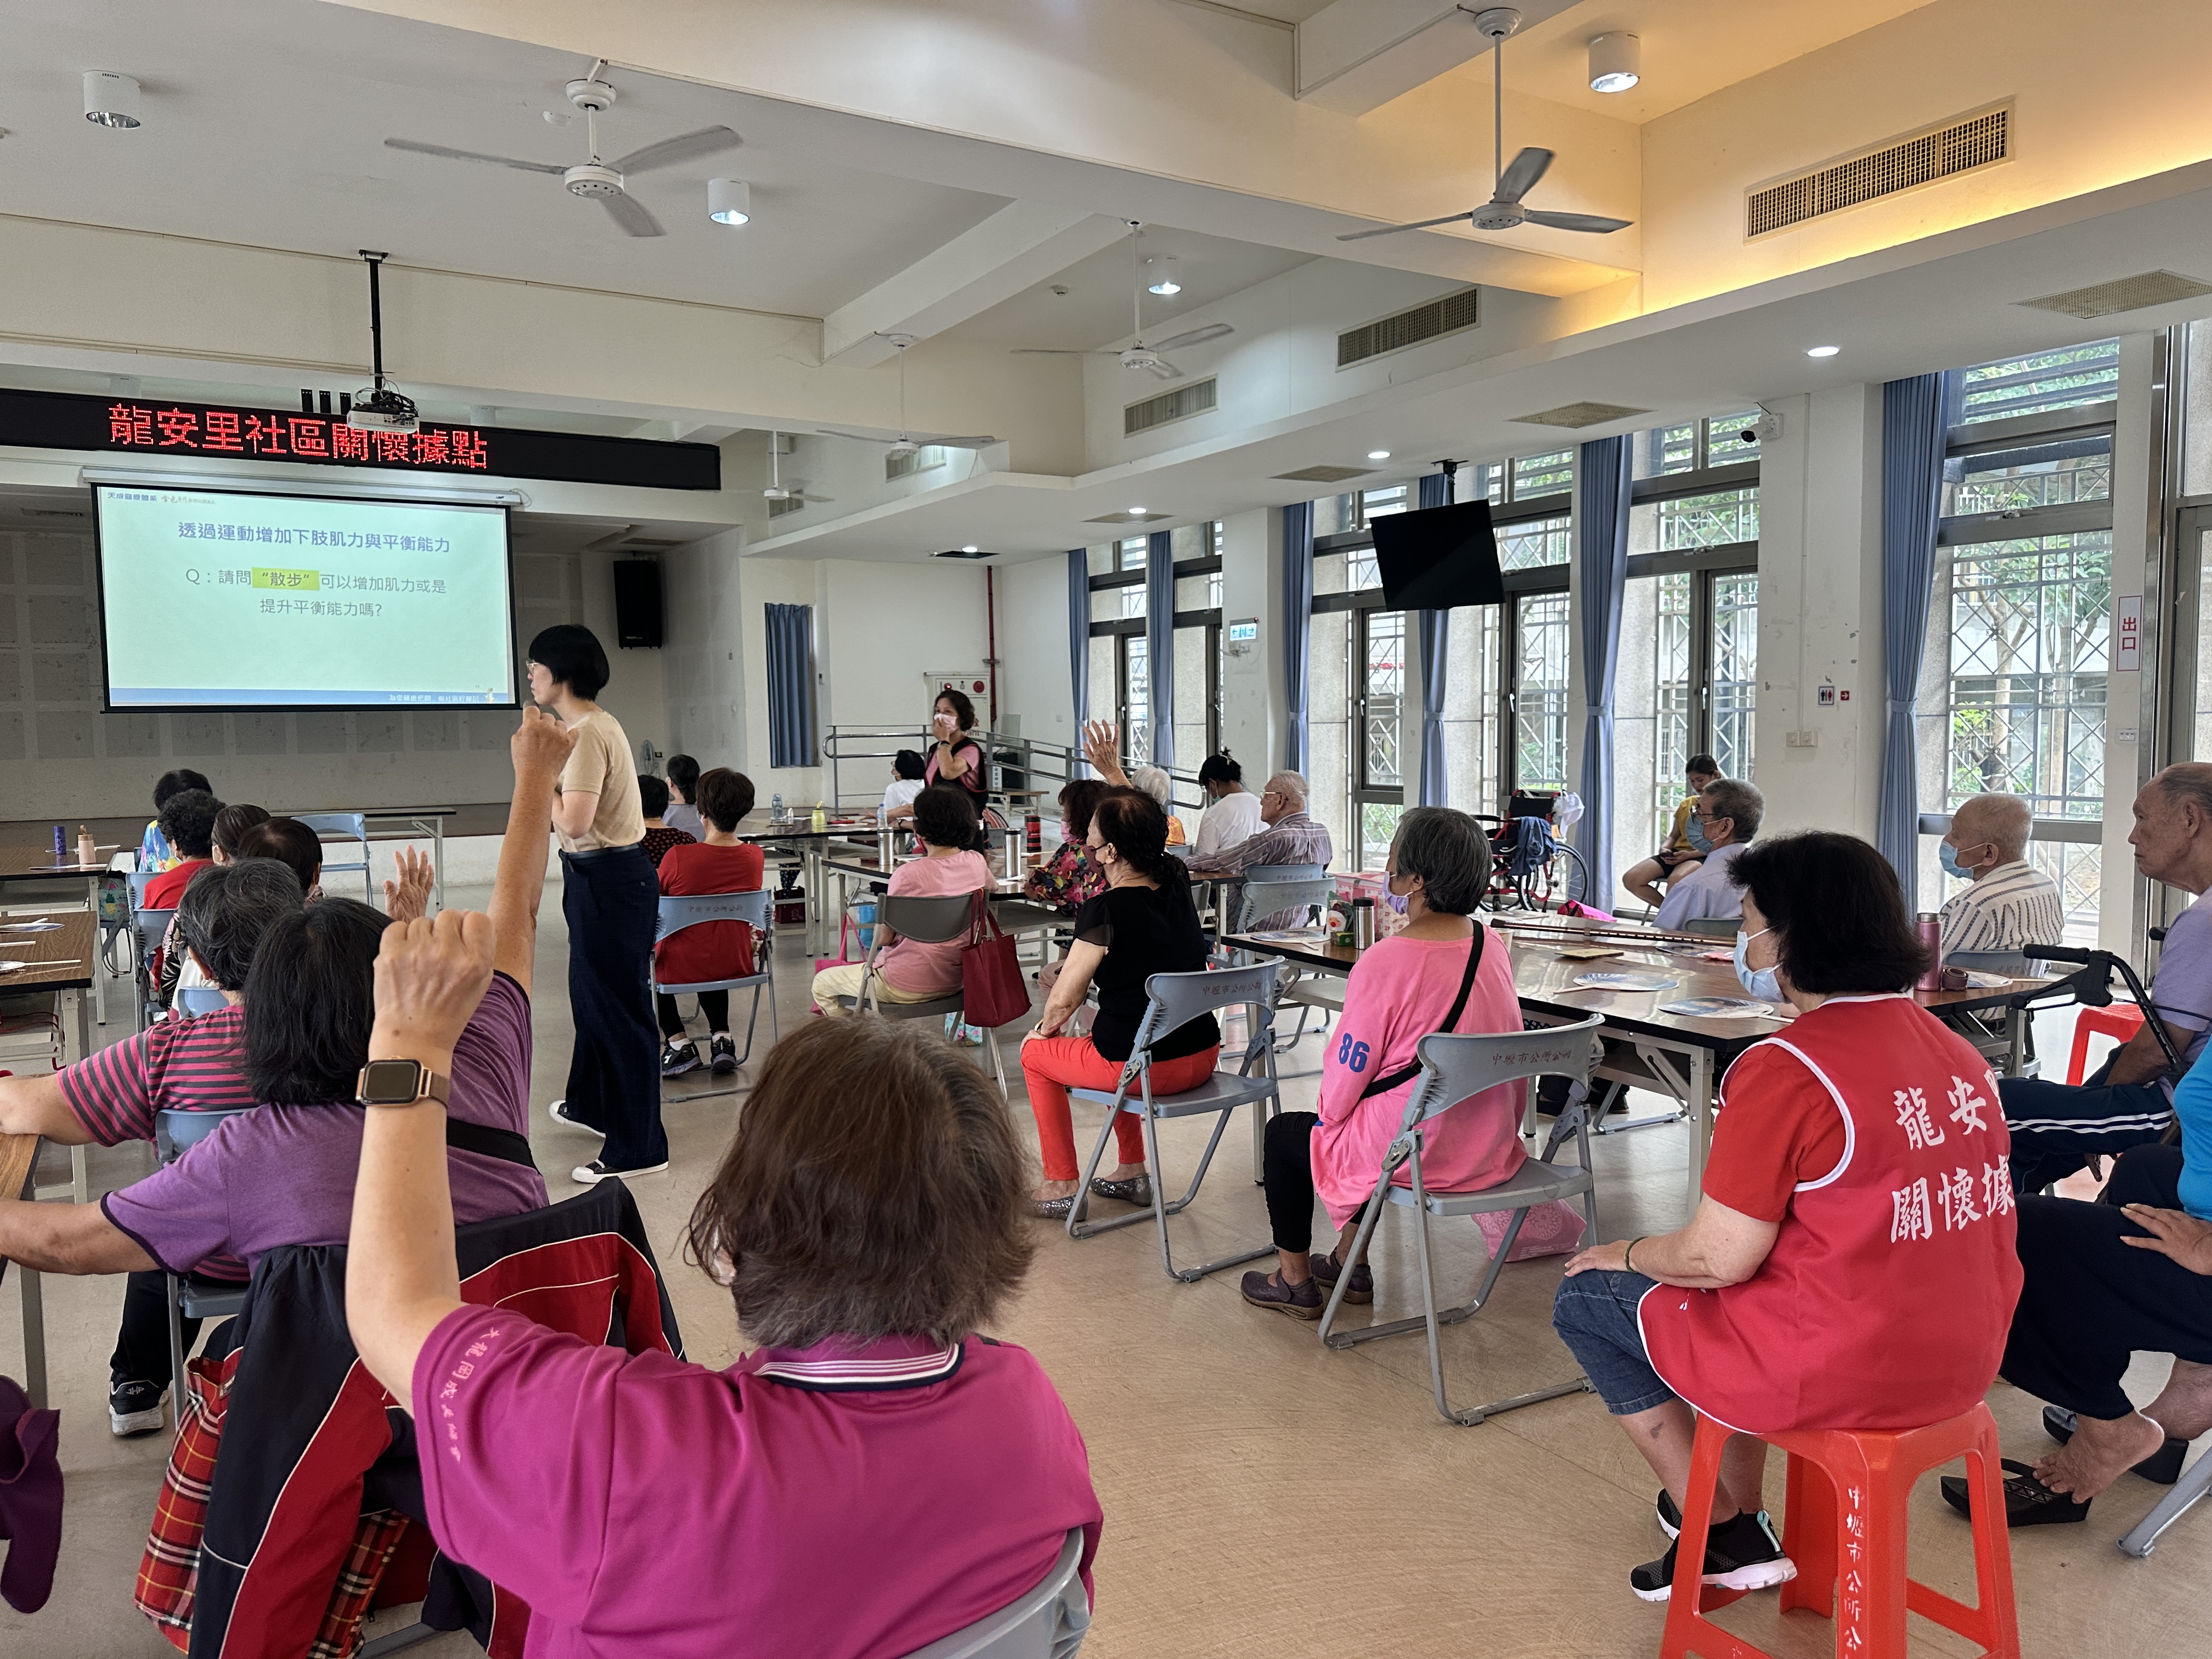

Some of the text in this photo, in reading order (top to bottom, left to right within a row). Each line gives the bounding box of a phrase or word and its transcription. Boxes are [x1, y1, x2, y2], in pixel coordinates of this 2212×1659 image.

[109, 403, 487, 469] 龍安里社區關懷據點
[178, 522, 450, 552] 透過運動增加下肢肌力與平衡能力
[2122, 617, 2137, 651] 出口
[1339, 1032, 1370, 1073] 86
[1844, 1485, 1865, 1659] 中壢市公所公
